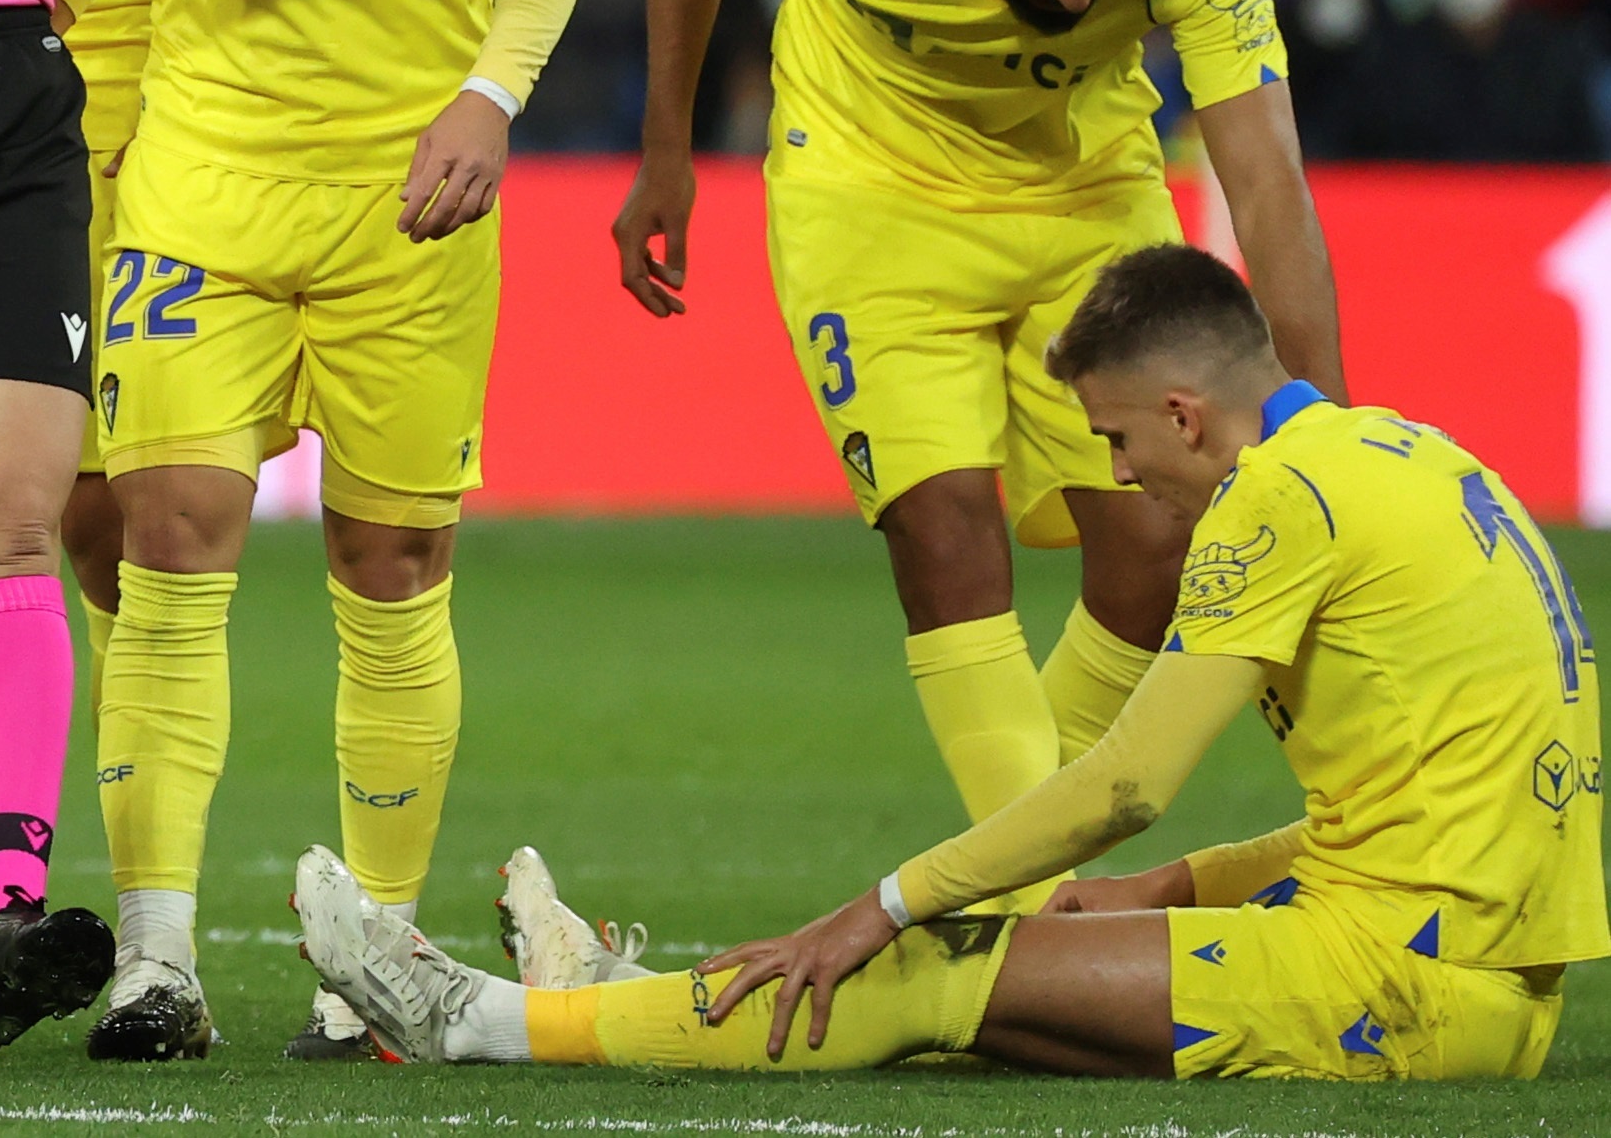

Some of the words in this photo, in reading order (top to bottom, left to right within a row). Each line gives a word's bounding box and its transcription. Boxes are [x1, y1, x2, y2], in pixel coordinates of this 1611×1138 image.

[103, 249, 205, 350] 22
[809, 312, 857, 411] 3
[345, 780, 419, 809] CCF
